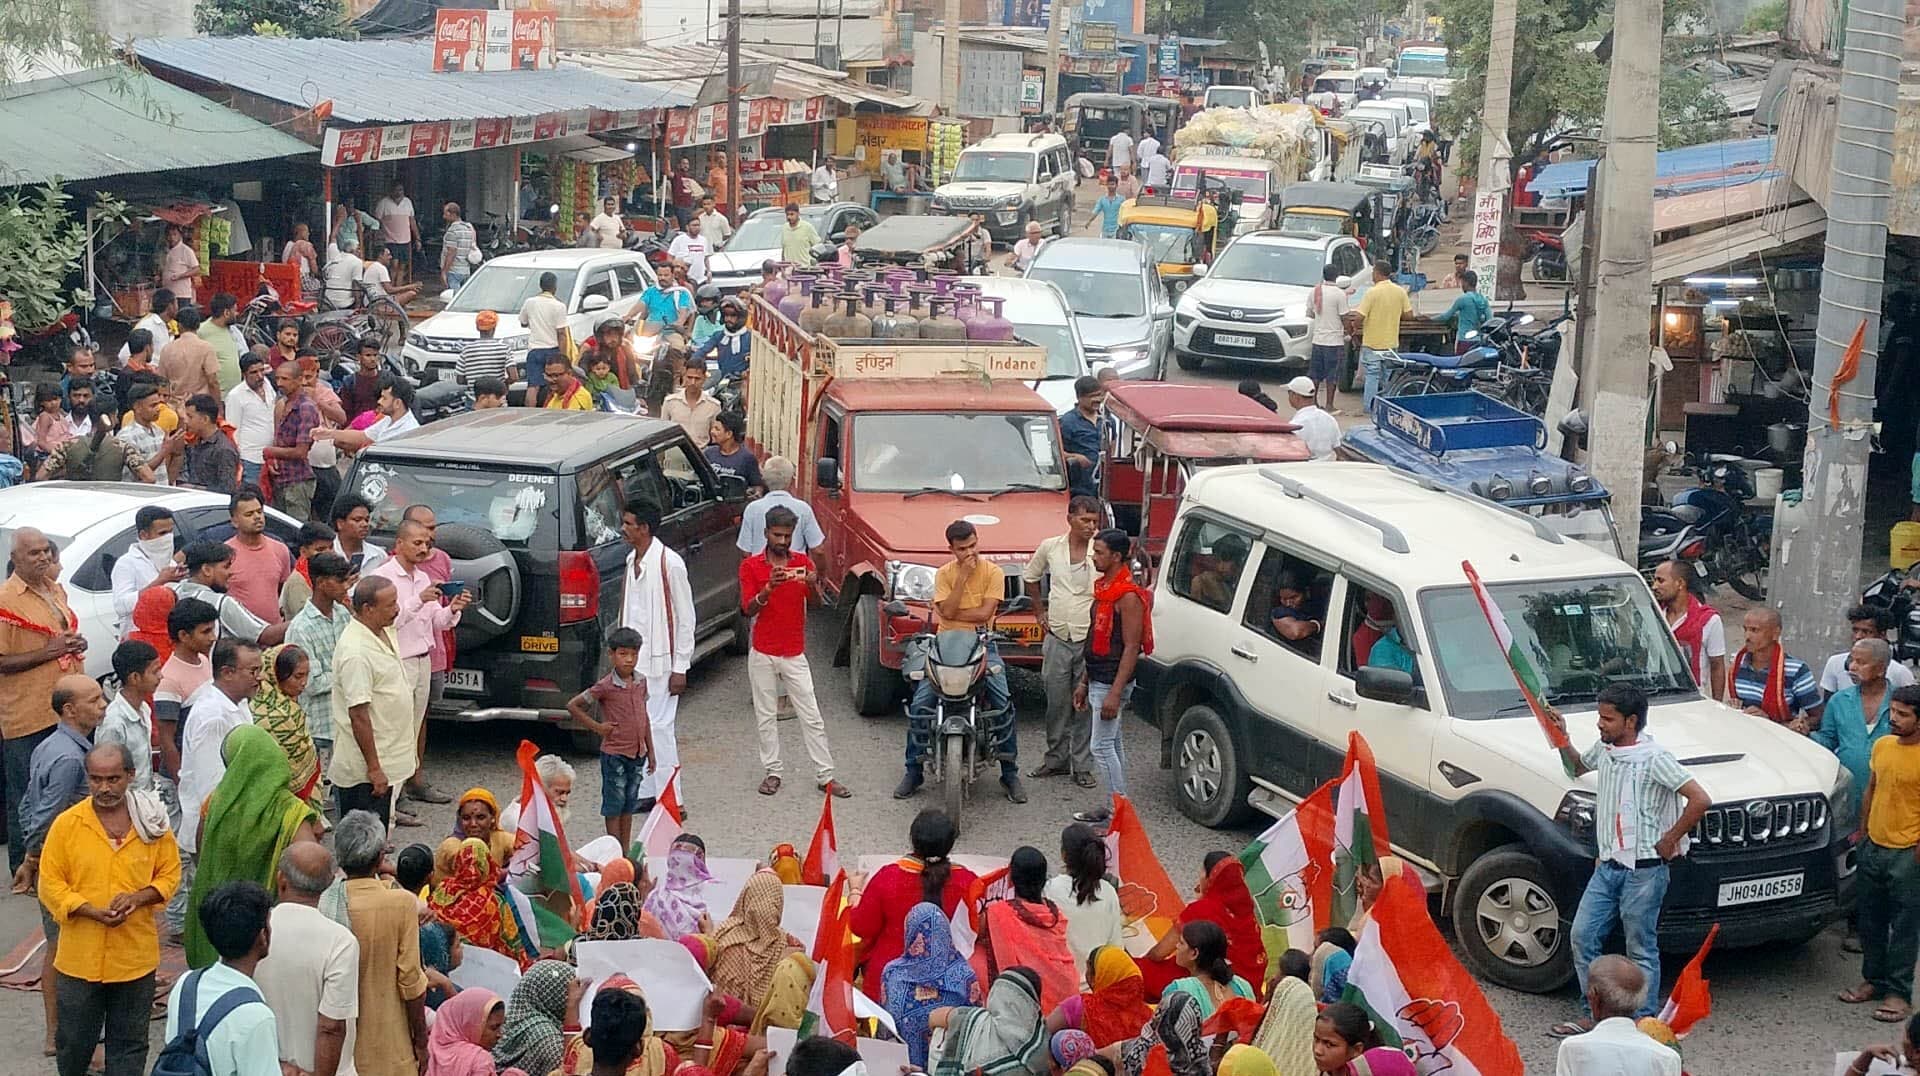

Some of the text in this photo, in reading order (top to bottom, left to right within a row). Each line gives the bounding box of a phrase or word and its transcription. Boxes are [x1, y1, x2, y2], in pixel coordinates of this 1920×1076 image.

[989, 355, 1037, 371] Indane
[508, 474, 556, 485] DEFENCE
[523, 641, 558, 651] DRIVE
